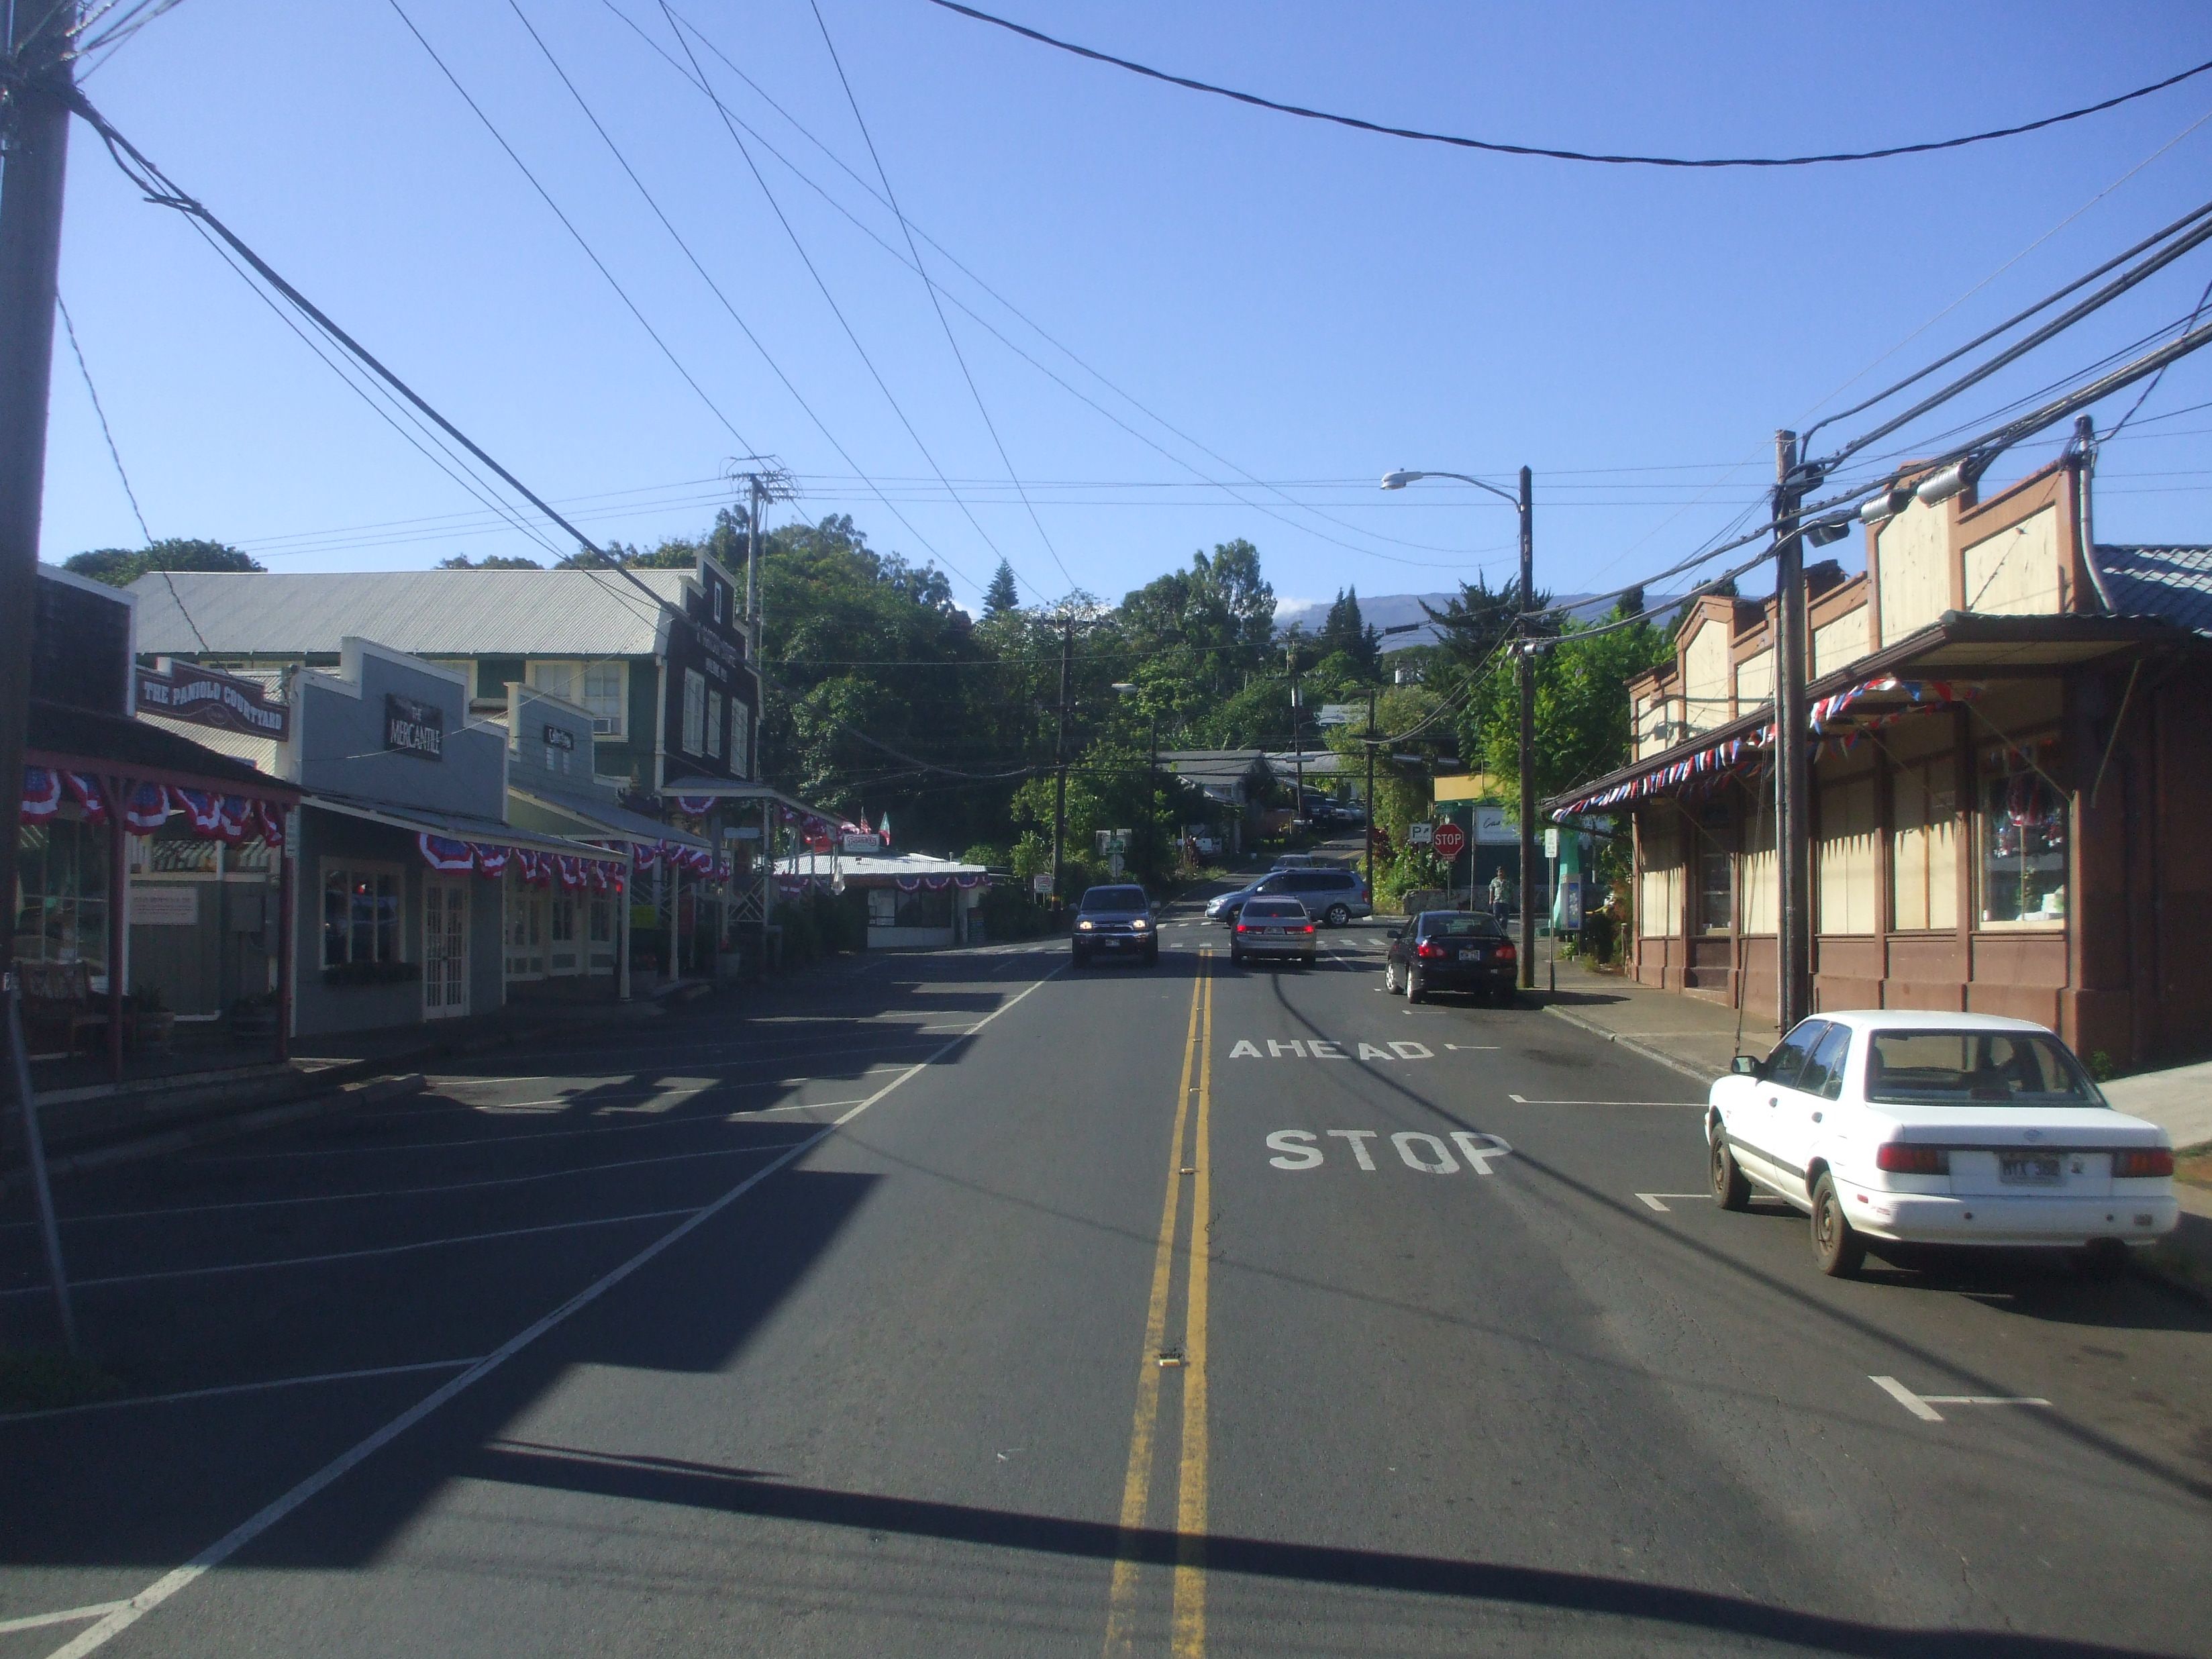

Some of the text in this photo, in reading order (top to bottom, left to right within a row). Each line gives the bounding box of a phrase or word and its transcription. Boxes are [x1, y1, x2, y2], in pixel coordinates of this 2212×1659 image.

[144, 681, 282, 730] THE PANIOLO COURTYARD
[411, 706, 423, 722] THE
[390, 719, 440, 754] MERCANTILE
[1434, 834, 1462, 846] STOP
[1229, 1040, 1436, 1060] AHEAD
[1265, 1128, 1513, 1175] STOP
